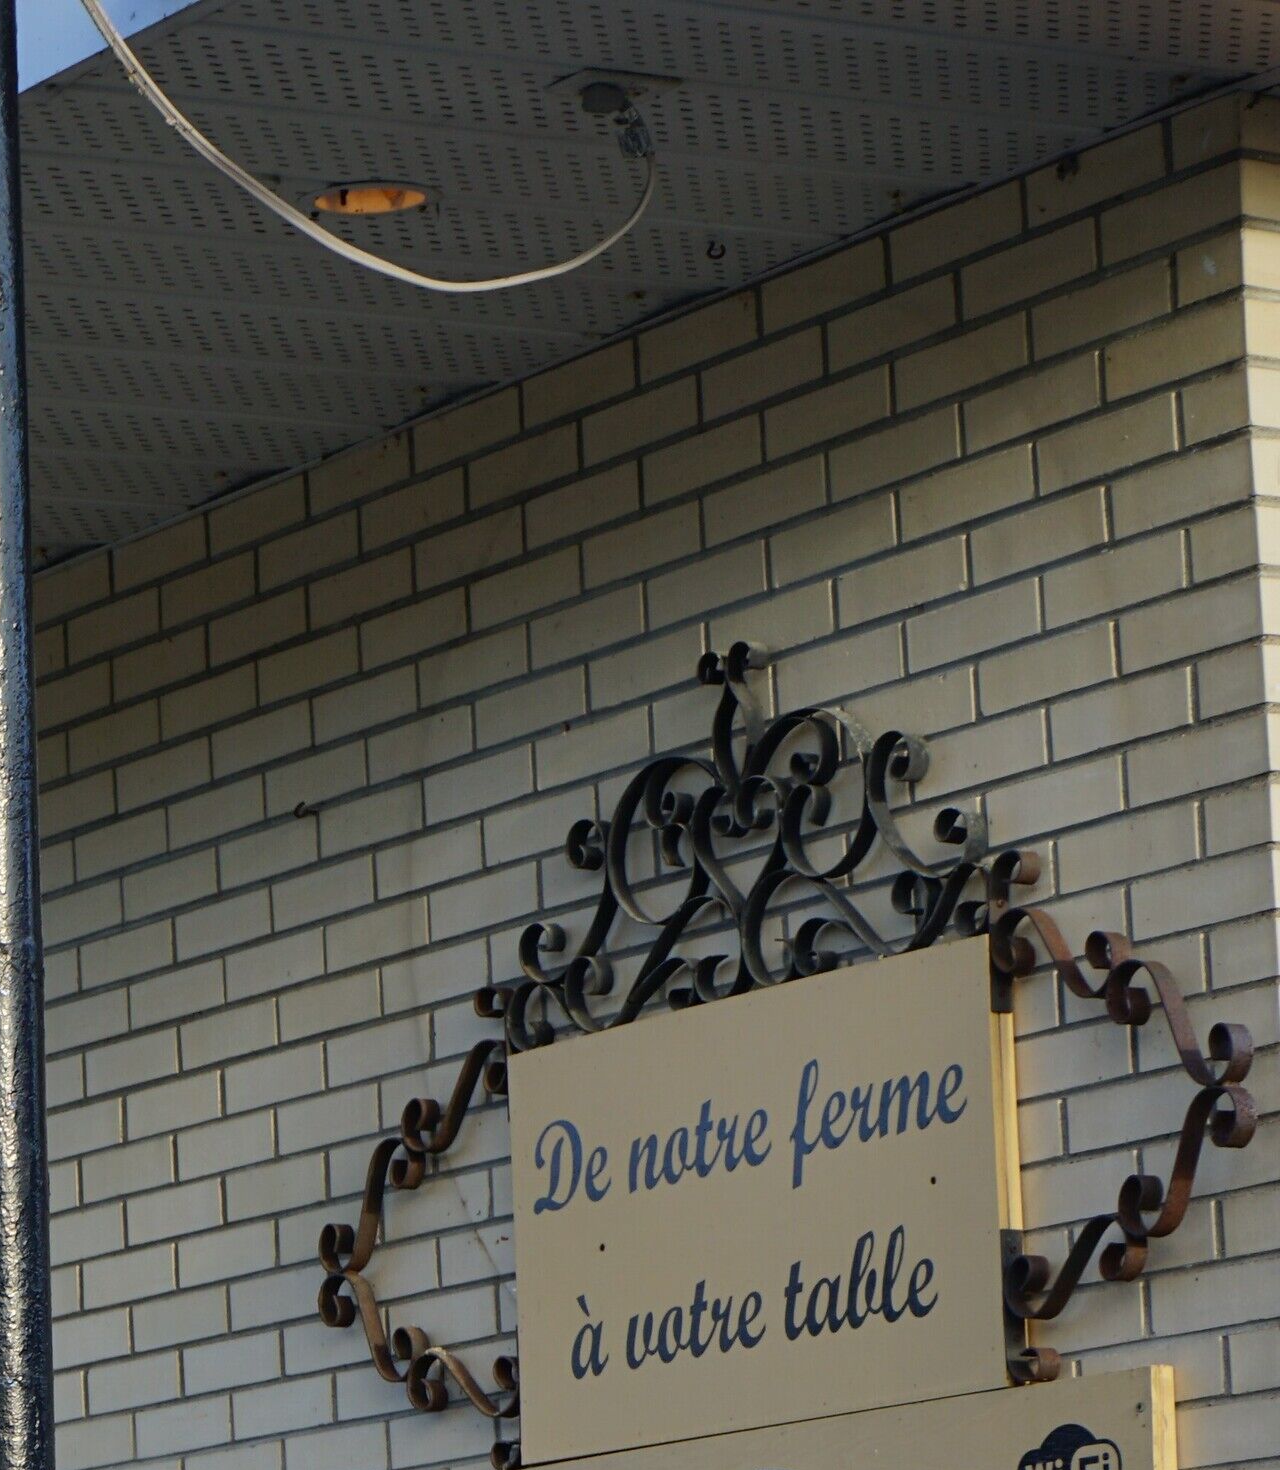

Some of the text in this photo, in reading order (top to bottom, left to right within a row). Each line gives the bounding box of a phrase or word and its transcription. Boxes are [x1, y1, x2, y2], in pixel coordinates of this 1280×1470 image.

[533, 1058, 968, 1215] De notre ferme
[570, 1225, 938, 1380] à votre table
